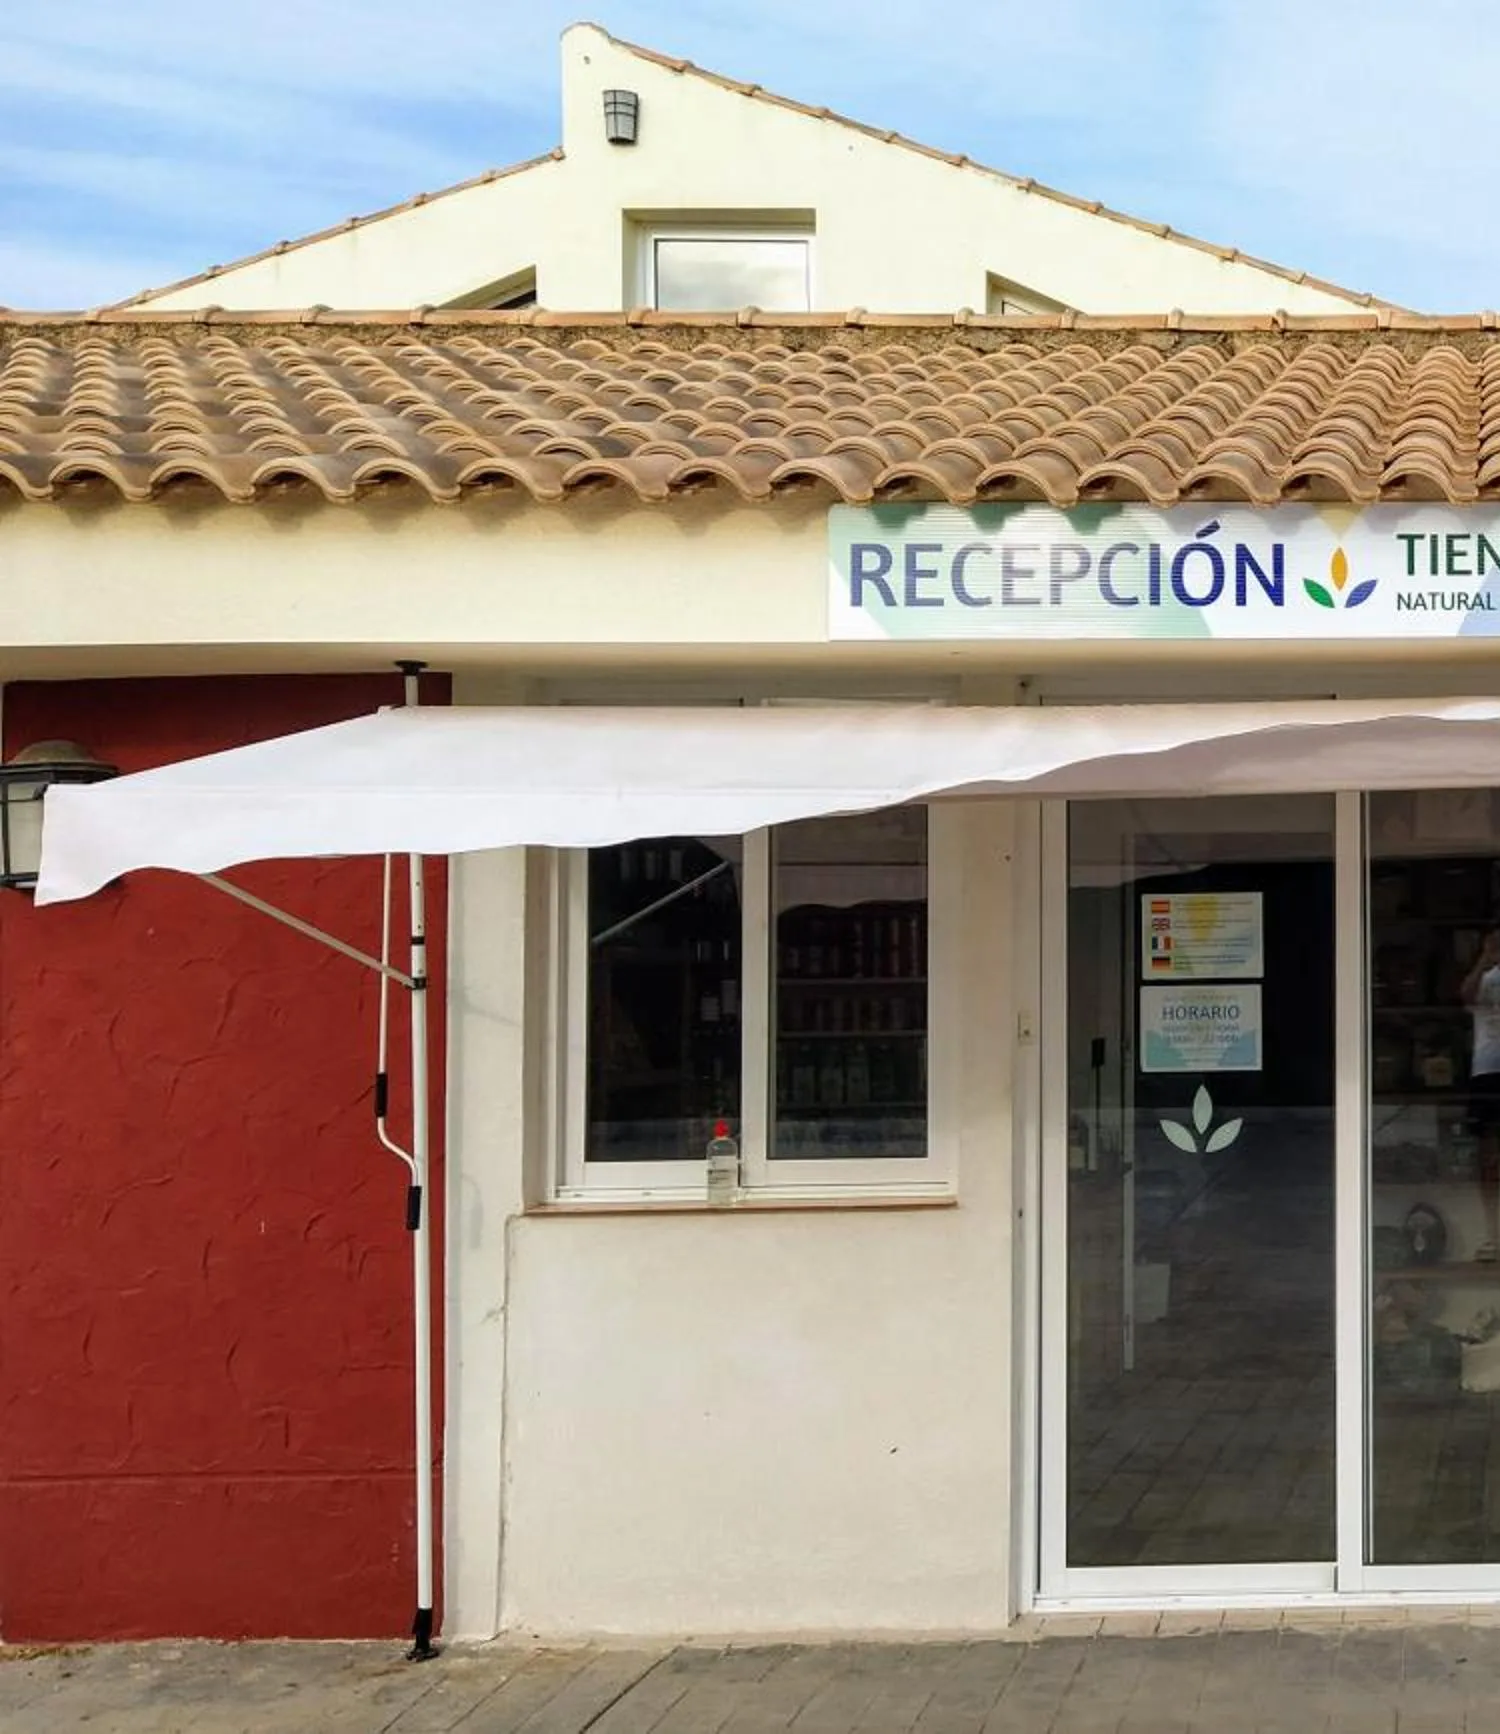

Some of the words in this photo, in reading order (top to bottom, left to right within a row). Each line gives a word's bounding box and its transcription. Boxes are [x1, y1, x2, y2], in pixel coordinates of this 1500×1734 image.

[849, 519, 1285, 607] RECEPCIÓN
[1396, 592, 1497, 611] NATURAL
[1161, 1005, 1241, 1021] HORARIO
